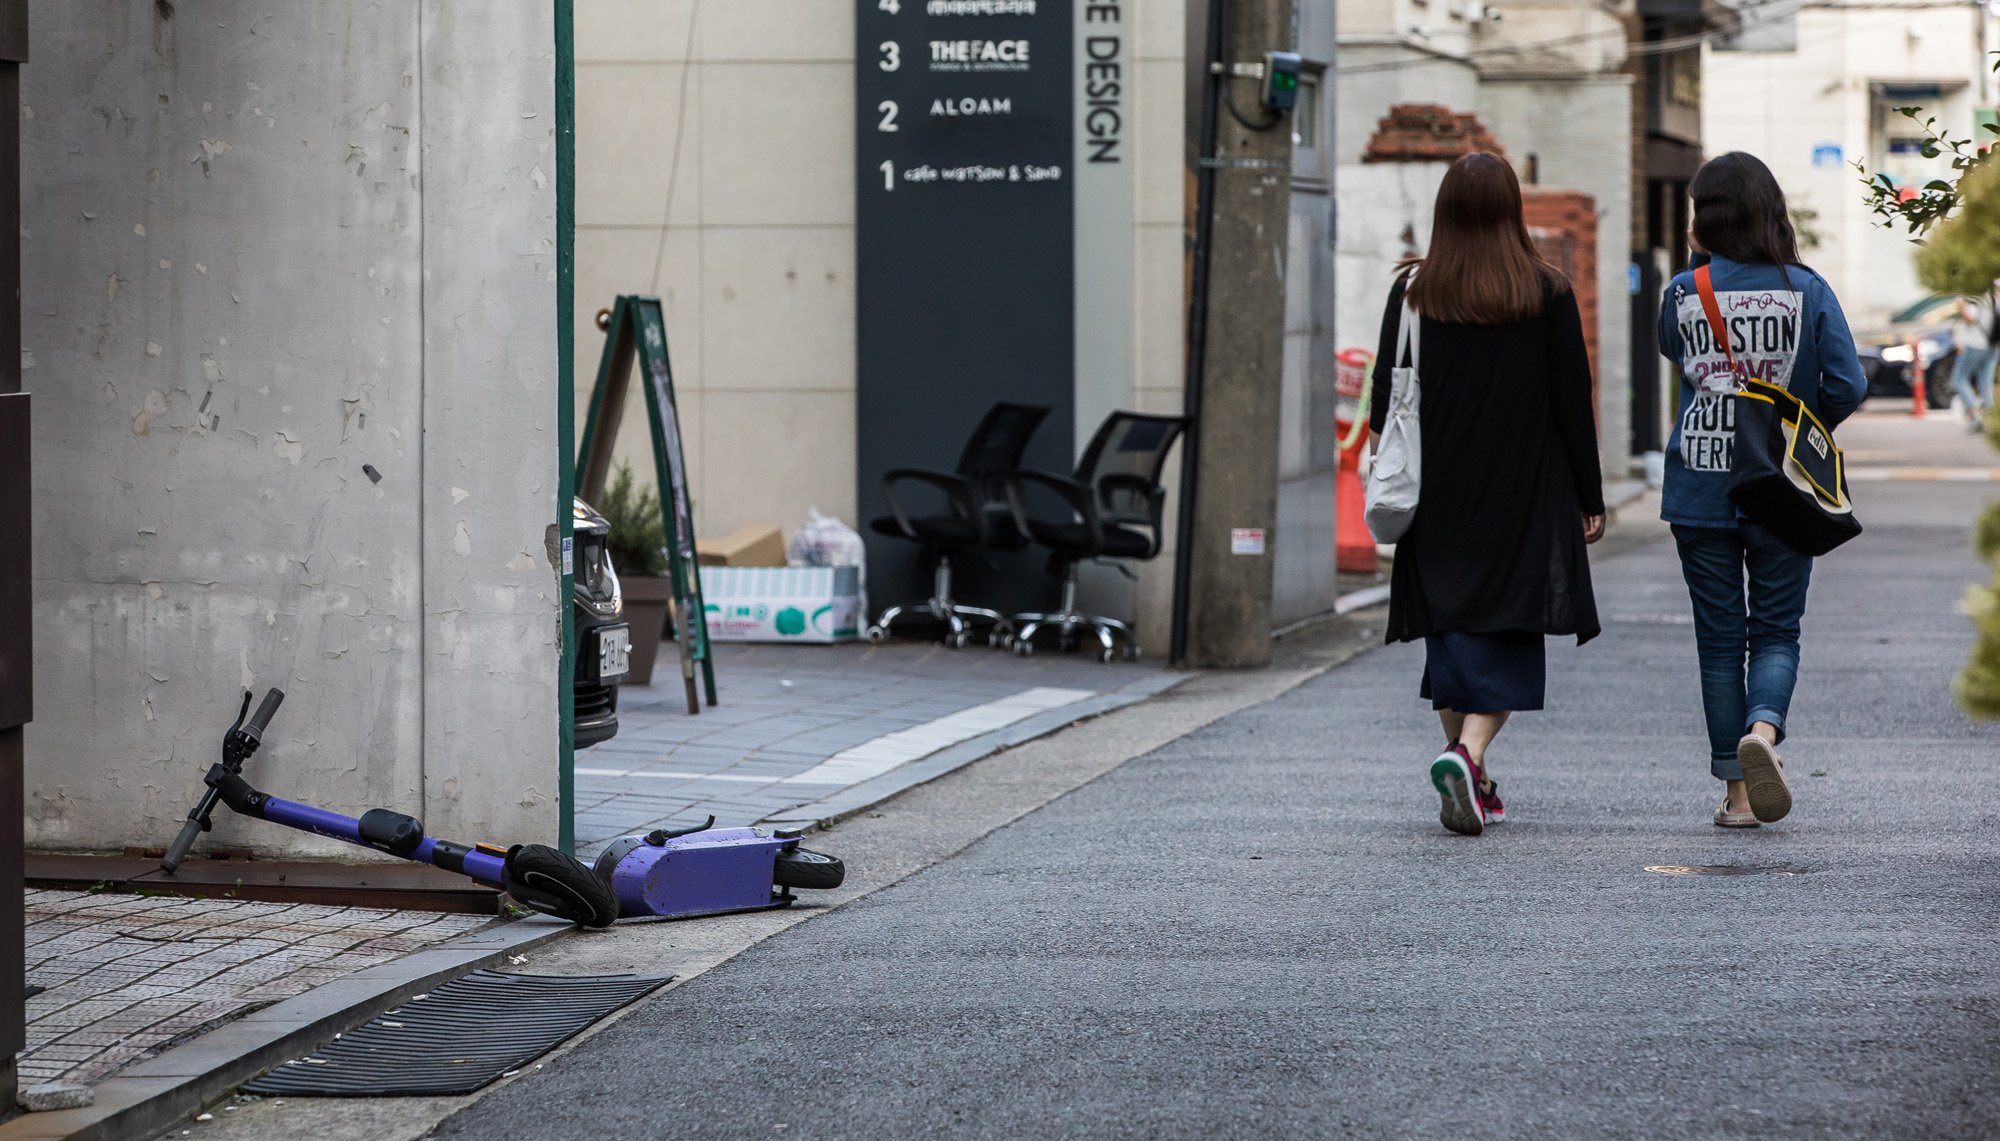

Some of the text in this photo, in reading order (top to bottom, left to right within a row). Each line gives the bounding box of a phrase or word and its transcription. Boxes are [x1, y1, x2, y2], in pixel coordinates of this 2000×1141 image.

[879, 40, 900, 72] 3
[878, 98, 1011, 132] 2 ALOAM
[1086, 36, 1121, 164] DESIGN
[880, 160, 894, 191] 1
[1008, 165, 1020, 182] &
[1733, 359, 1782, 388] AVE
